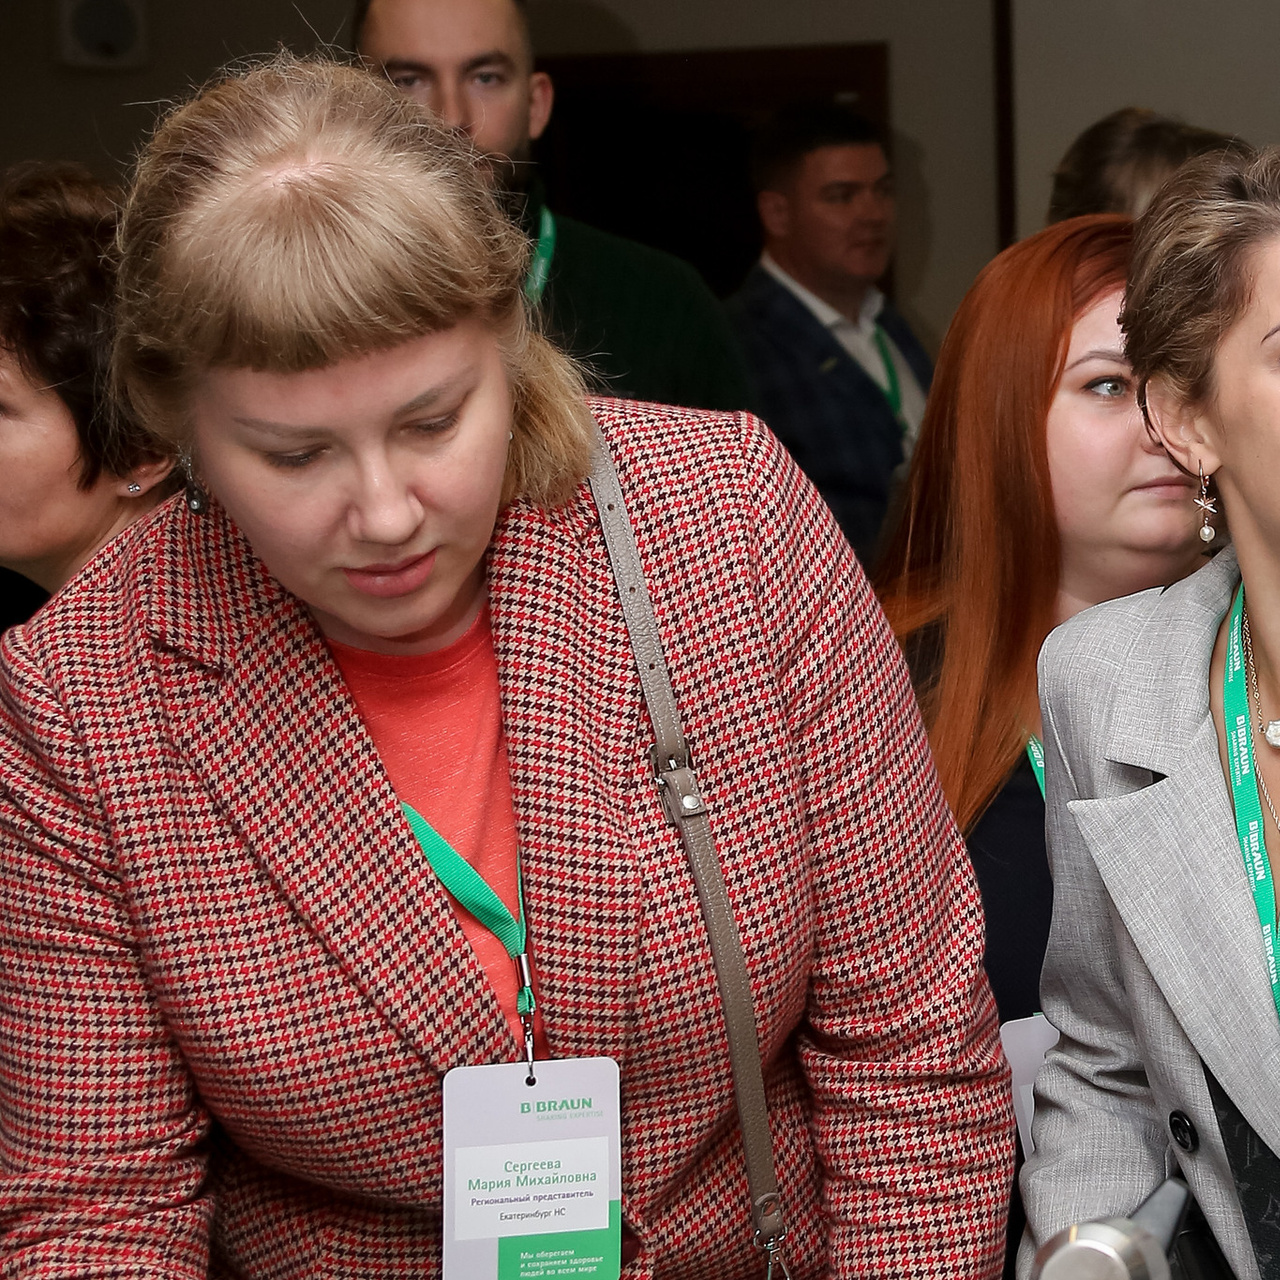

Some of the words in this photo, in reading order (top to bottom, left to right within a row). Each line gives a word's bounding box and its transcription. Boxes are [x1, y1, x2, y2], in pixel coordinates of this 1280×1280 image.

[504, 1160, 561, 1174] Сергеева
[468, 1179, 511, 1191] Мария
[516, 1172, 597, 1187] Михайловна
[471, 1194, 530, 1206] Региональный
[533, 1190, 594, 1203] представитель
[500, 1209, 552, 1221] Екатеринбург
